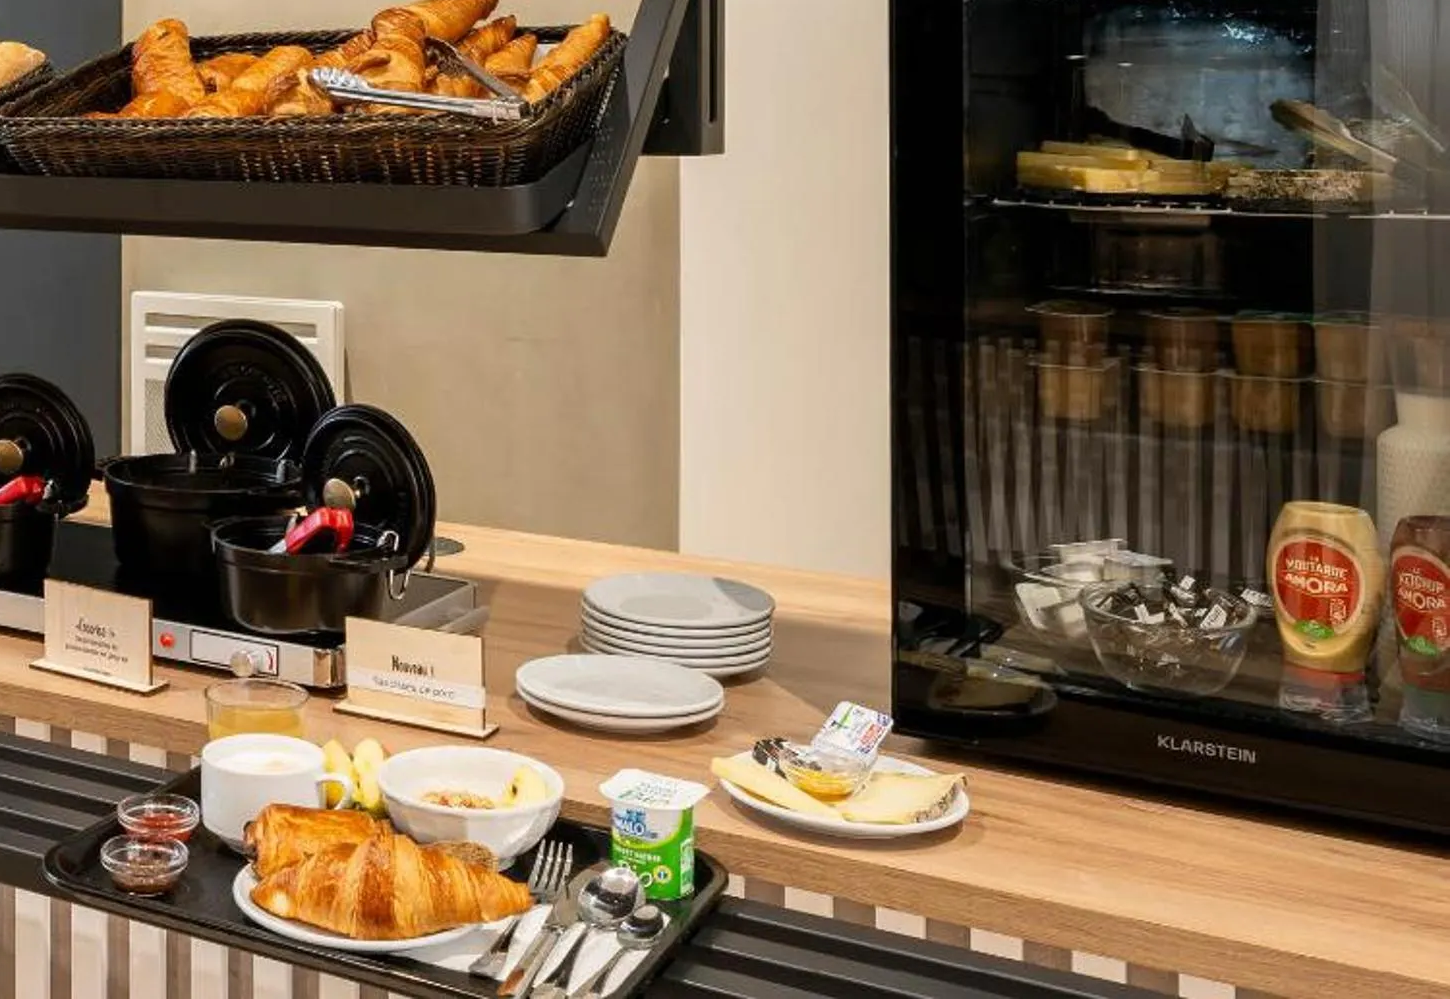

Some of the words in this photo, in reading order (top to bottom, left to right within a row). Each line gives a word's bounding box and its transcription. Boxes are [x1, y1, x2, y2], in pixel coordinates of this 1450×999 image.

[1285, 558, 1348, 579] MOUTARDE
[1285, 573, 1348, 594] AMORA
[1398, 587, 1446, 610] AMORA
[1157, 734, 1257, 765] KLARSTEIN
